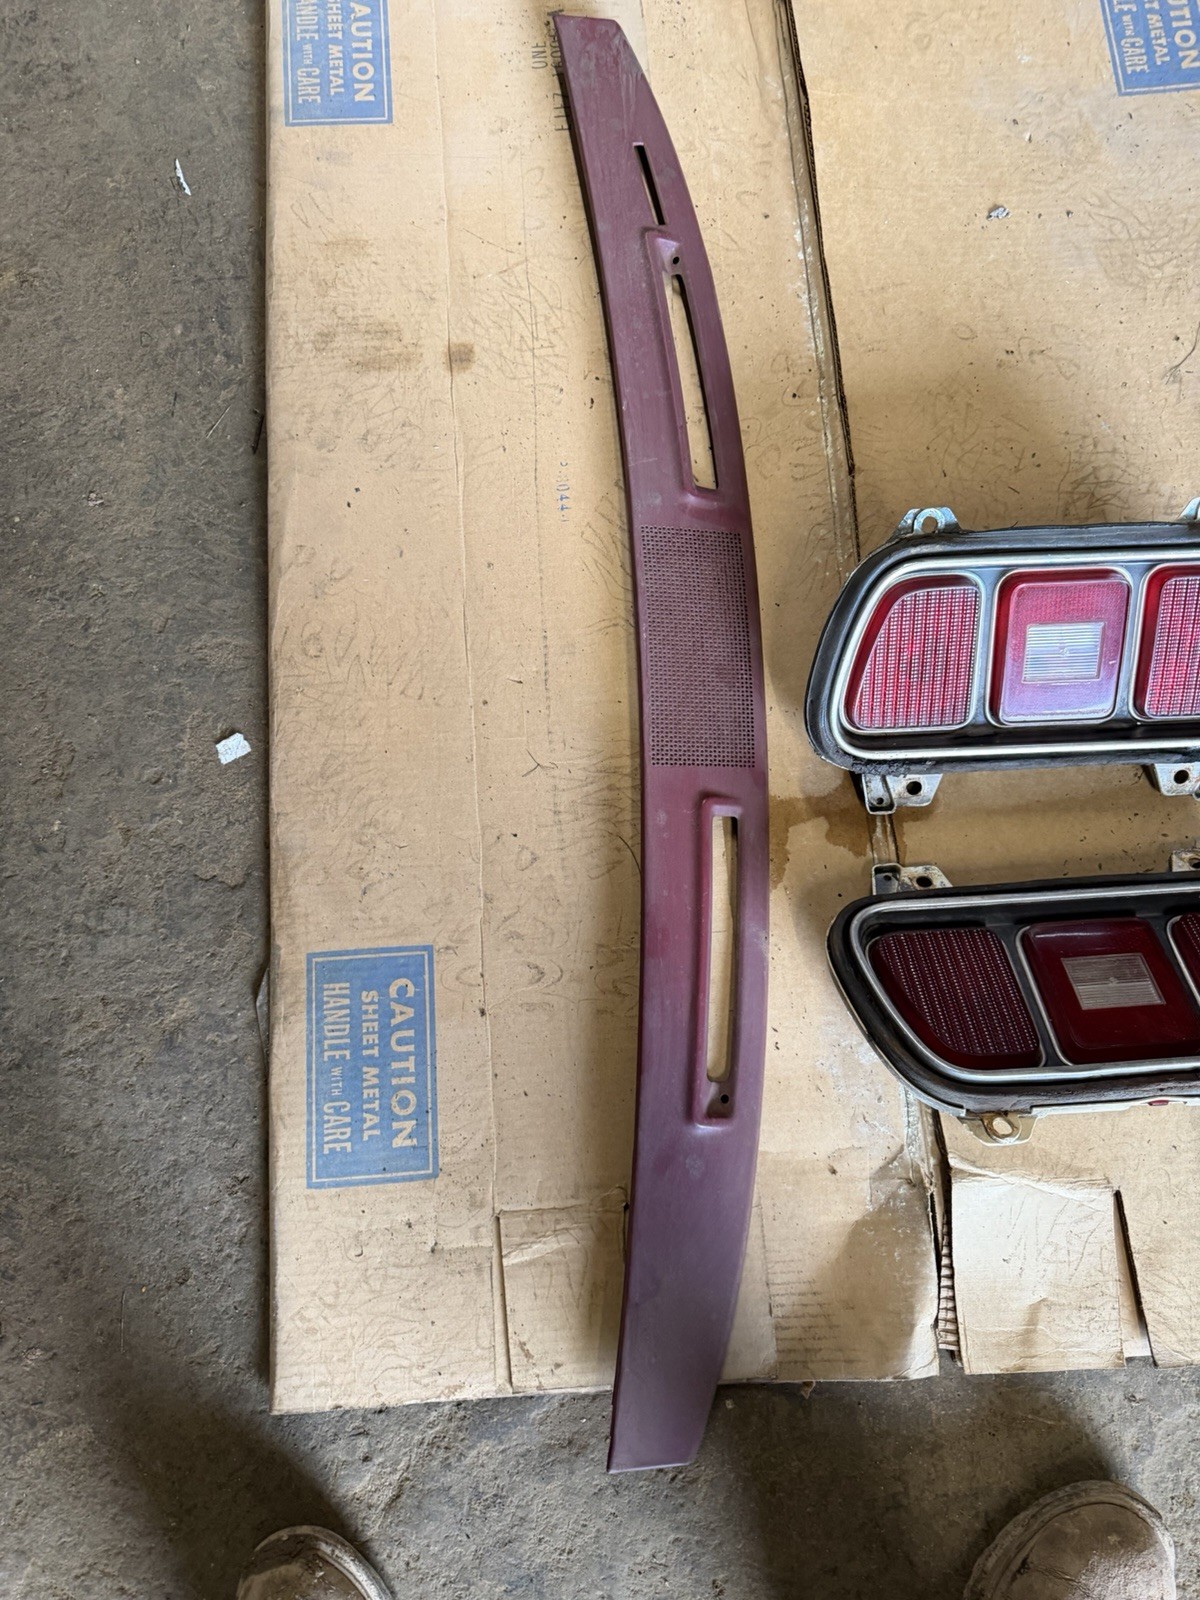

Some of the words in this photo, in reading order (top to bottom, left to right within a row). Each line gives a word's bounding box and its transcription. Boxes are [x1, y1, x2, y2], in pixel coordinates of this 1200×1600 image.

[1122, 14, 1135, 36] WITH
[1147, 13, 1170, 65] METAL
[302, 43, 313, 65] WITH
[328, 44, 345, 96] METAL
[1120, 37, 1150, 74] CARE
[297, 67, 321, 104] CARE
[323, 982, 350, 1062] HANDLE
[361, 990, 380, 1057] SHEET
[331, 1066, 343, 1096] WITH
[389, 977, 418, 1148] CAUTION
[322, 1101, 352, 1155] CARE
[361, 1066, 380, 1141] METAL
